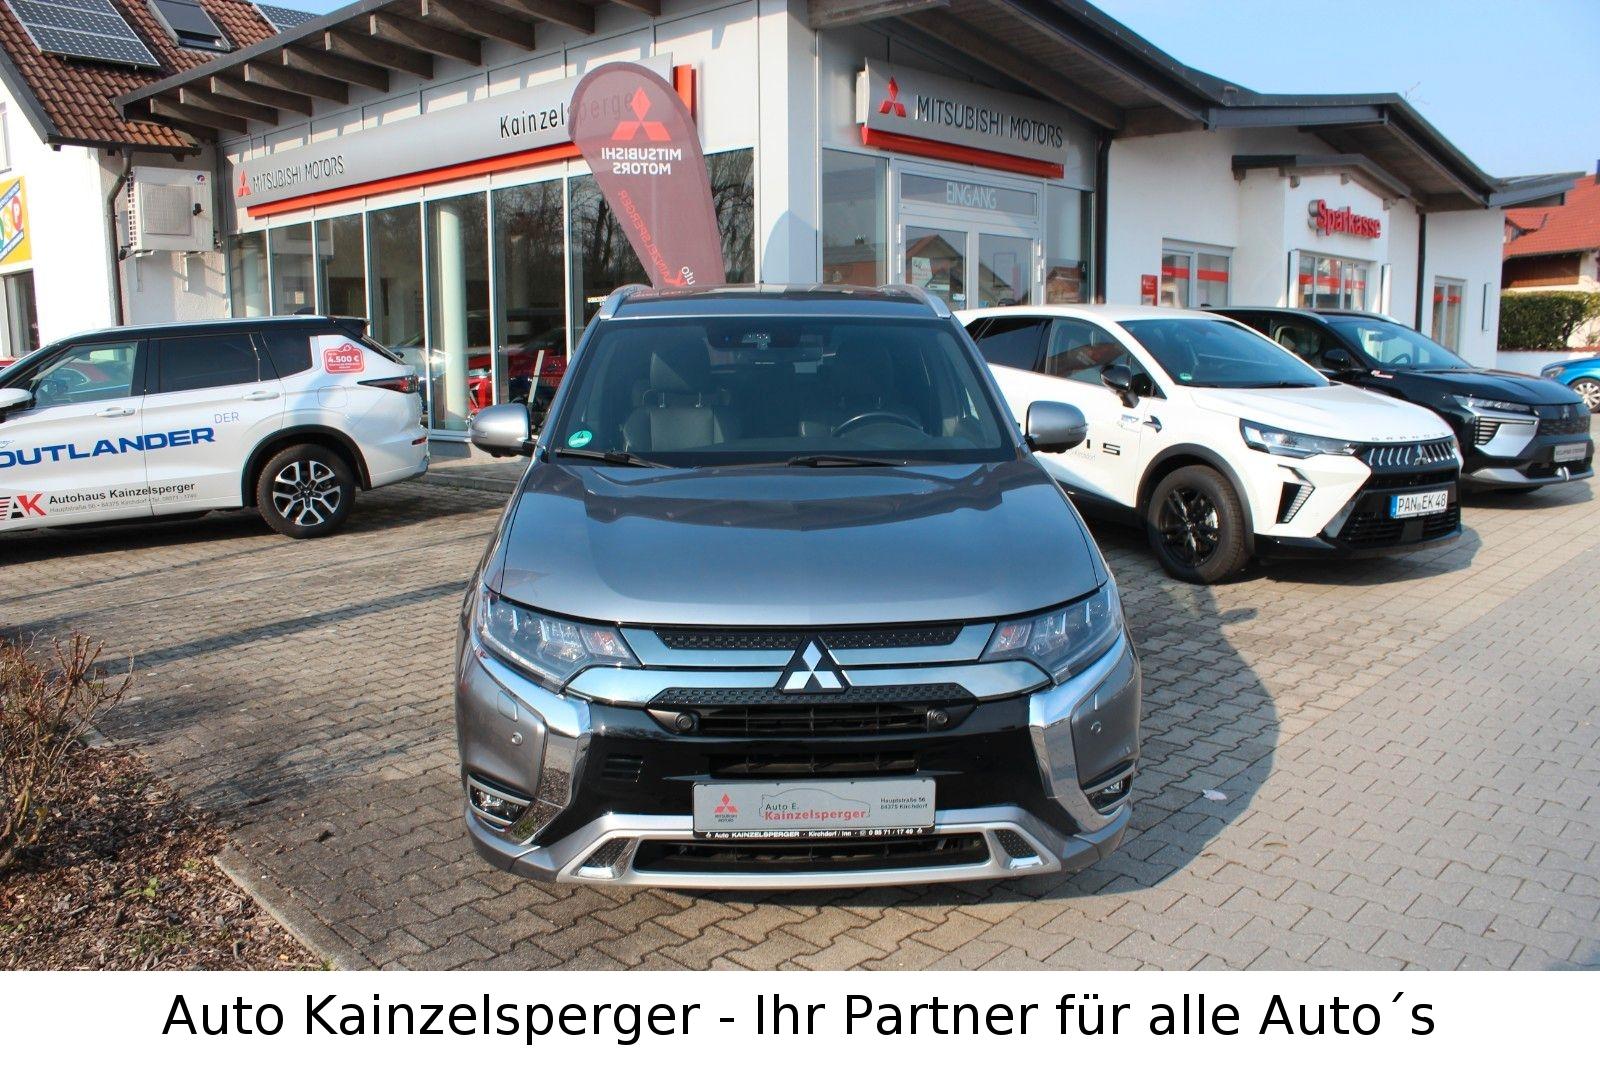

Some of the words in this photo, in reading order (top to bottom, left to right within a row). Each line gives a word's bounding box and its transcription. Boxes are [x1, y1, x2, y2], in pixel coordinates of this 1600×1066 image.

[914, 94, 1004, 137] MITSUBISHI
[1009, 115, 1064, 149] MOTORS
[252, 164, 303, 193] MITSUBISHI
[304, 155, 345, 181] MOTORS
[946, 181, 997, 210] EINGANG
[1314, 199, 1382, 239] Sparkasse
[214, 411, 240, 424] DER
[0, 426, 216, 469] OUTLANDER
[49, 492, 106, 505] Autohaus
[109, 483, 196, 500] Kainzelsperger
[1398, 497, 1418, 512] PAN
[1421, 494, 1435, 510] EK
[1435, 493, 1447, 508] 48
[764, 809, 867, 821] Kainzelsperger
[765, 803, 788, 811] Auto
[791, 802, 800, 810] E.
[732, 831, 800, 839] KAINZELSPERGER
[808, 830, 837, 838] Kirchdorf
[841, 830, 852, 838] Inn
